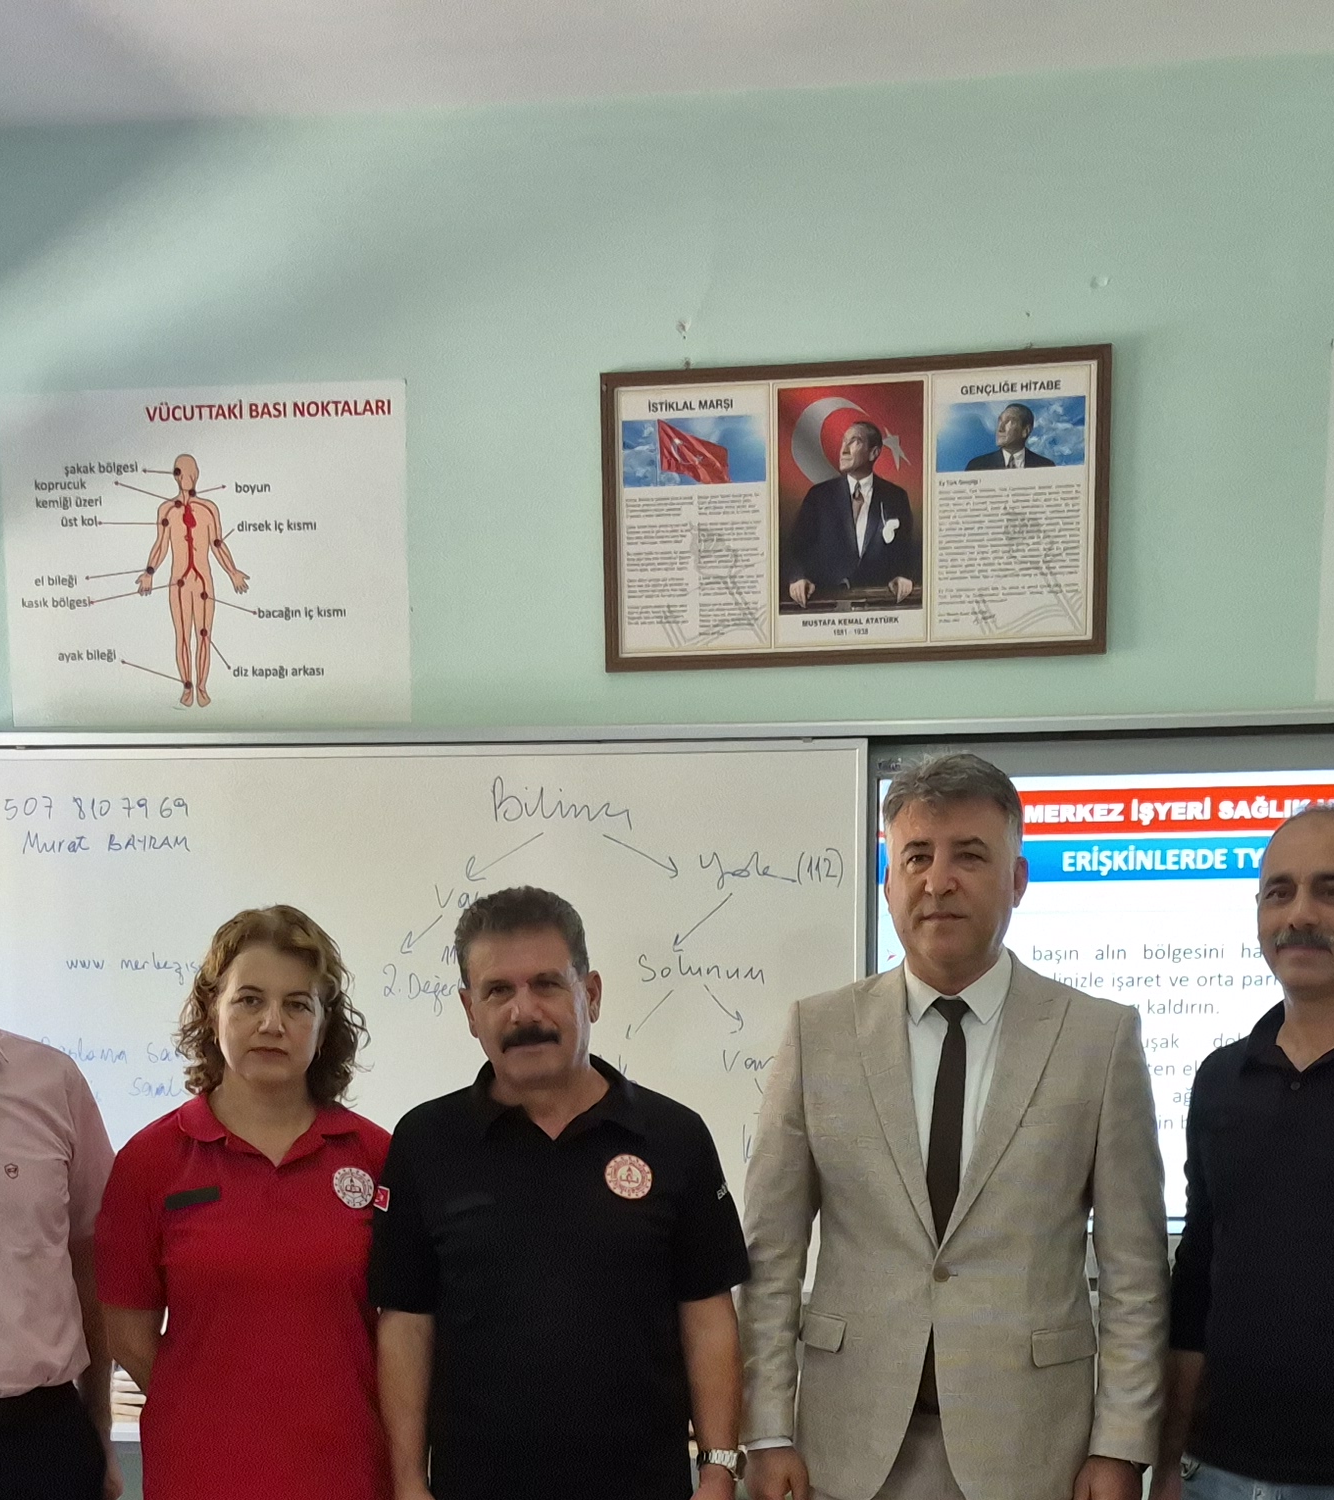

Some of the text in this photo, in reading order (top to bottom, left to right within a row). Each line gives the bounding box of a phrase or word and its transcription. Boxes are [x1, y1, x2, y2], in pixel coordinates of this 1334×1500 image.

[960, 379, 1061, 396] GENÇLİĞE HİTABE
[145, 399, 391, 422] VÜCUTTAKİ BASI NOKTALARI
[648, 398, 734, 413] İSTİKLAL MARŞI
[64, 461, 138, 477] şakak bölgesi
[235, 482, 271, 495] boyun
[75, 496, 102, 508] üzeri
[61, 515, 98, 527] üst kol
[237, 520, 271, 532] dirsek
[287, 519, 317, 531] kısmı
[34, 574, 77, 588] el bileği
[21, 596, 91, 610] kasık bölgesi
[257, 606, 302, 621] bacağın
[317, 606, 346, 618] kısmı
[802, 616, 899, 627] MUSTAFA KEMAL ATATÜRK
[58, 649, 117, 663] ayak bileği
[233, 665, 325, 679] diz kapağı arkası
[4, 795, 53, 821] 507
[73, 795, 111, 821] 810
[122, 796, 149, 819] 79
[1024, 802, 1124, 824] MERKEZ
[1130, 798, 1211, 826] İŞYERİ
[22, 830, 191, 855] Murat BAYRAM
[1062, 844, 1228, 877] ERİŞKİNLERDE
[1032, 942, 1262, 963] başın alın bölgesini ha
[66, 958, 106, 970] www
[638, 954, 766, 984] Solunum
[1111, 973, 1234, 994] işaret ve orta
[1146, 998, 1220, 1015] kaldırın.
